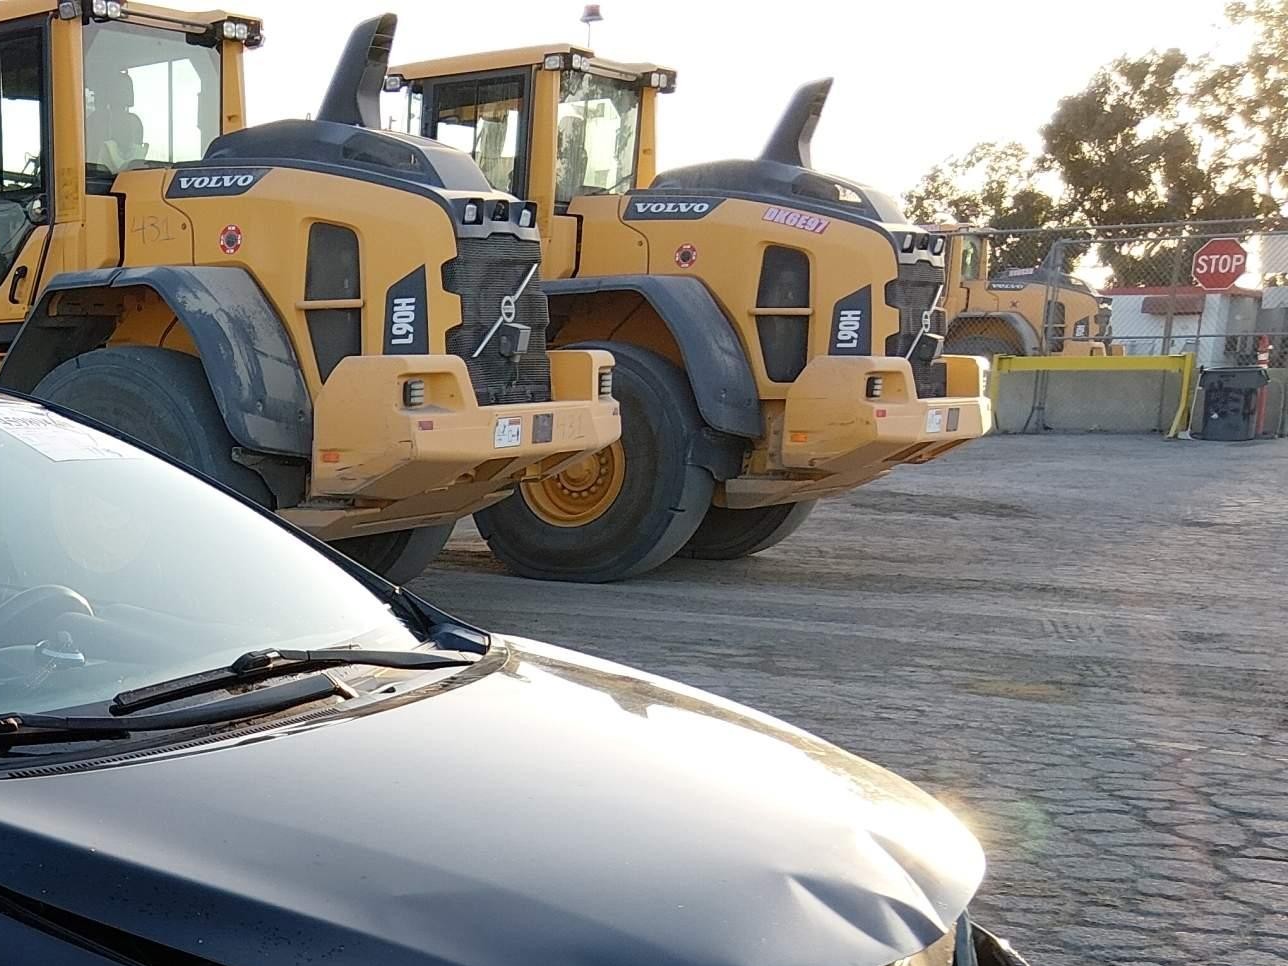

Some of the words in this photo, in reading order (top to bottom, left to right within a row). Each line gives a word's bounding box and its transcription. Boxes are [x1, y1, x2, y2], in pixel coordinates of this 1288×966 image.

[179, 174, 254, 189] VOLVO
[635, 202, 709, 213] VOLVO
[130, 215, 176, 245] 431
[1196, 254, 1245, 274] STOP
[391, 297, 416, 345] L90H
[836, 310, 861, 348] L90H
